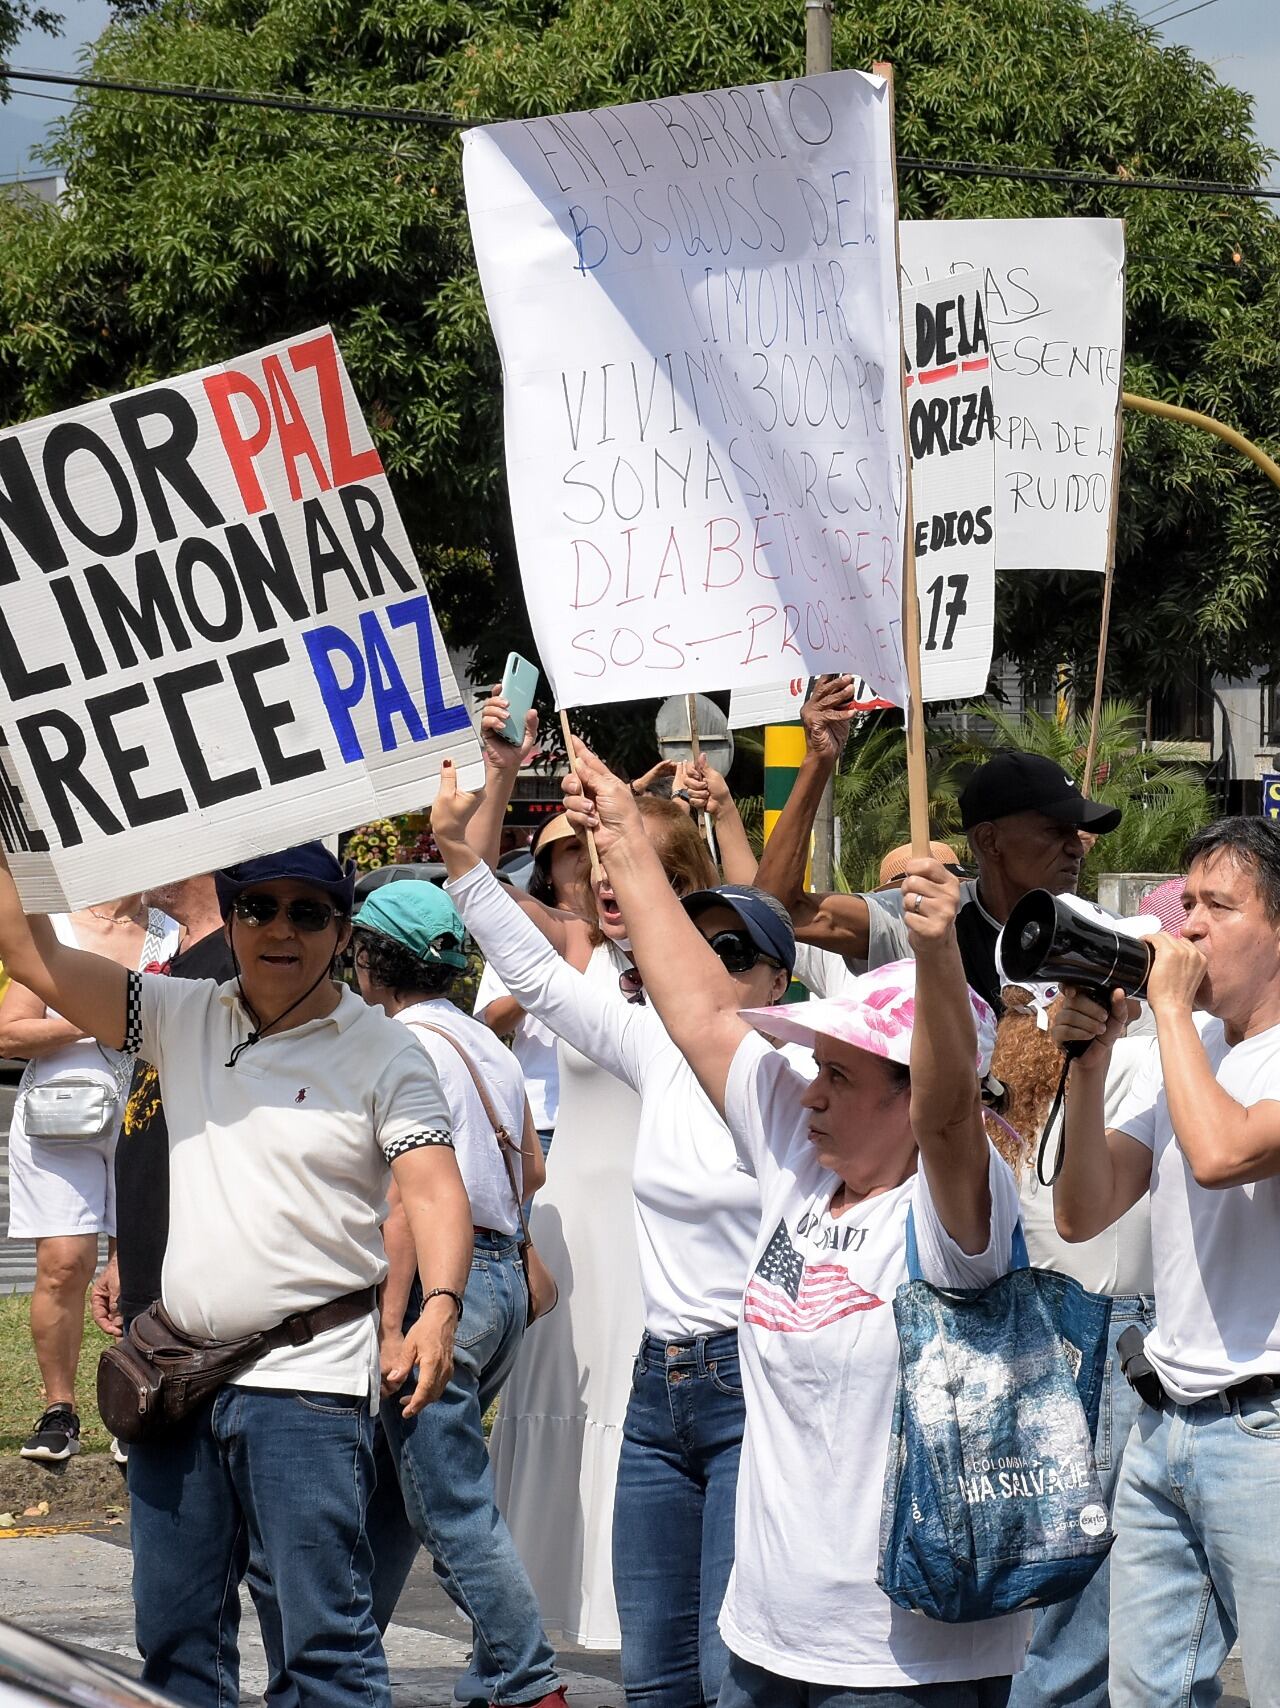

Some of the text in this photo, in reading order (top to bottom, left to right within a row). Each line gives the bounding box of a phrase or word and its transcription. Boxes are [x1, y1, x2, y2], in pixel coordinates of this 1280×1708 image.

[681, 260, 853, 348] LIMONAR
[202, 333, 385, 516] PAZ
[0, 484, 417, 701] LIMONAR
[924, 573, 970, 651] 17
[301, 594, 472, 764] PAZ
[972, 1456, 1029, 1473] COLOMBIA
